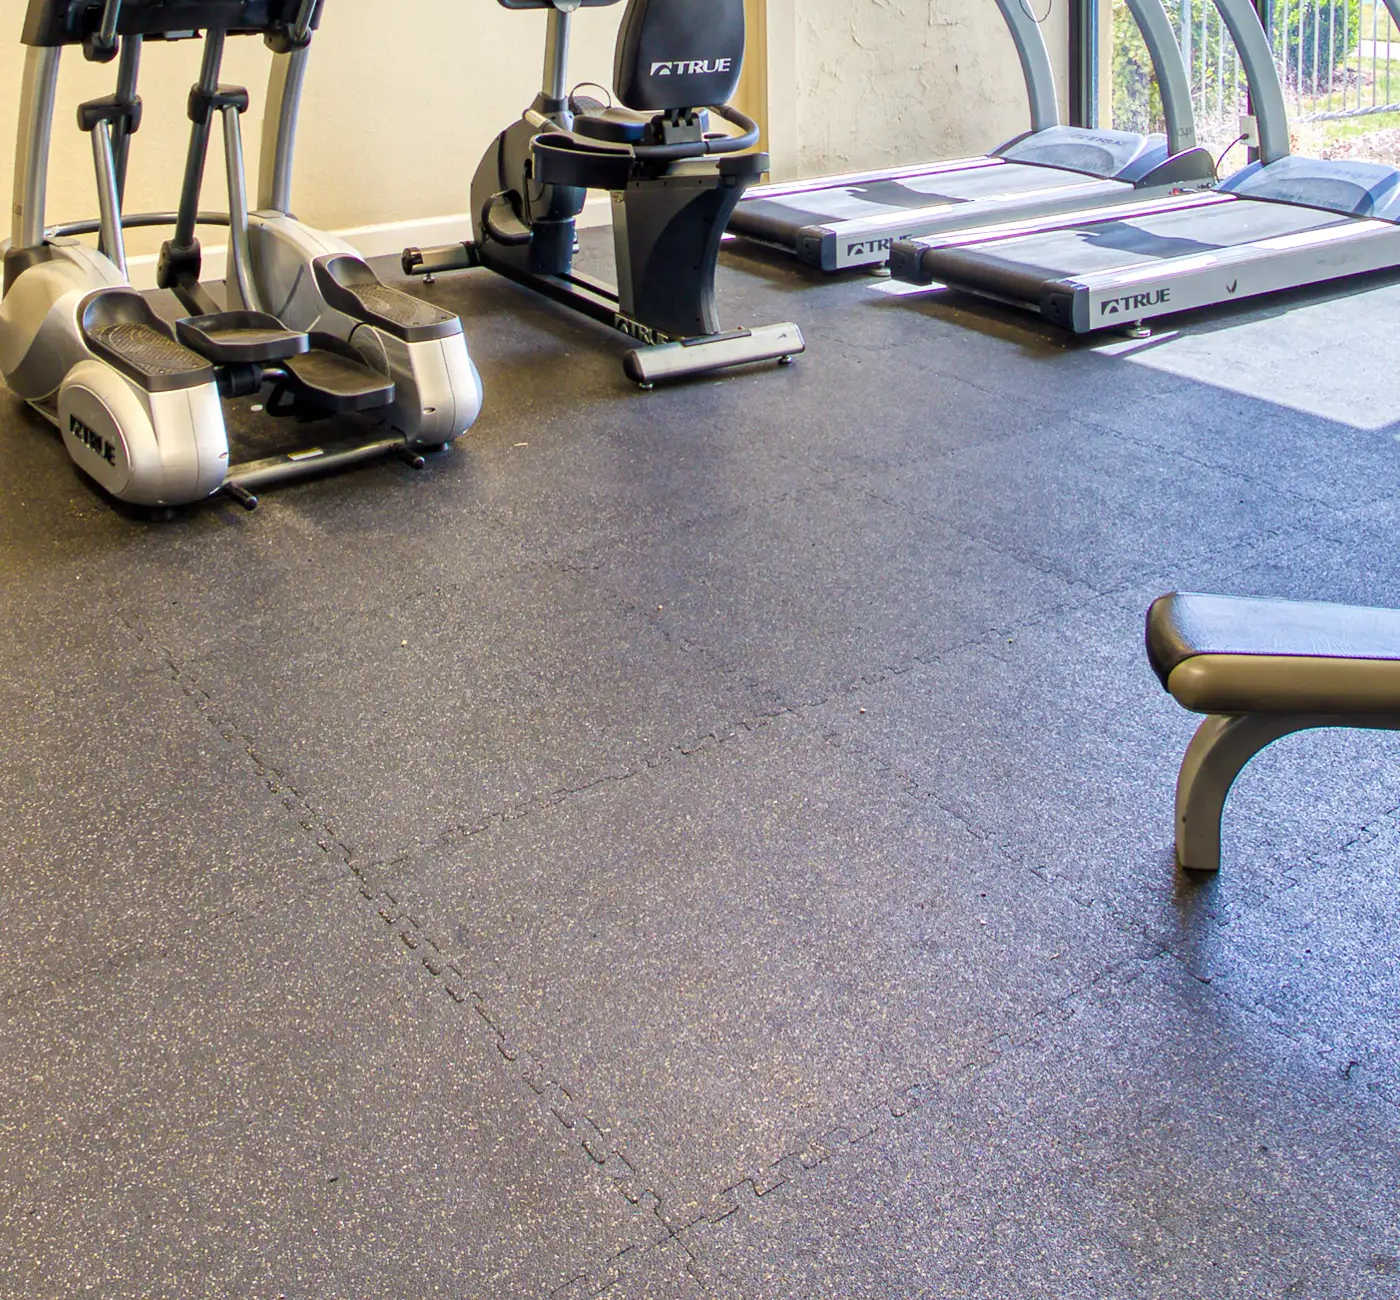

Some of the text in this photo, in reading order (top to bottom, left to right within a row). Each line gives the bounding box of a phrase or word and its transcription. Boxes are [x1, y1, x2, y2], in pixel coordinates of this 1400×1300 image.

[674, 57, 732, 75] TRUE
[1120, 288, 1171, 311] TRUE
[83, 426, 116, 467] TRUE
